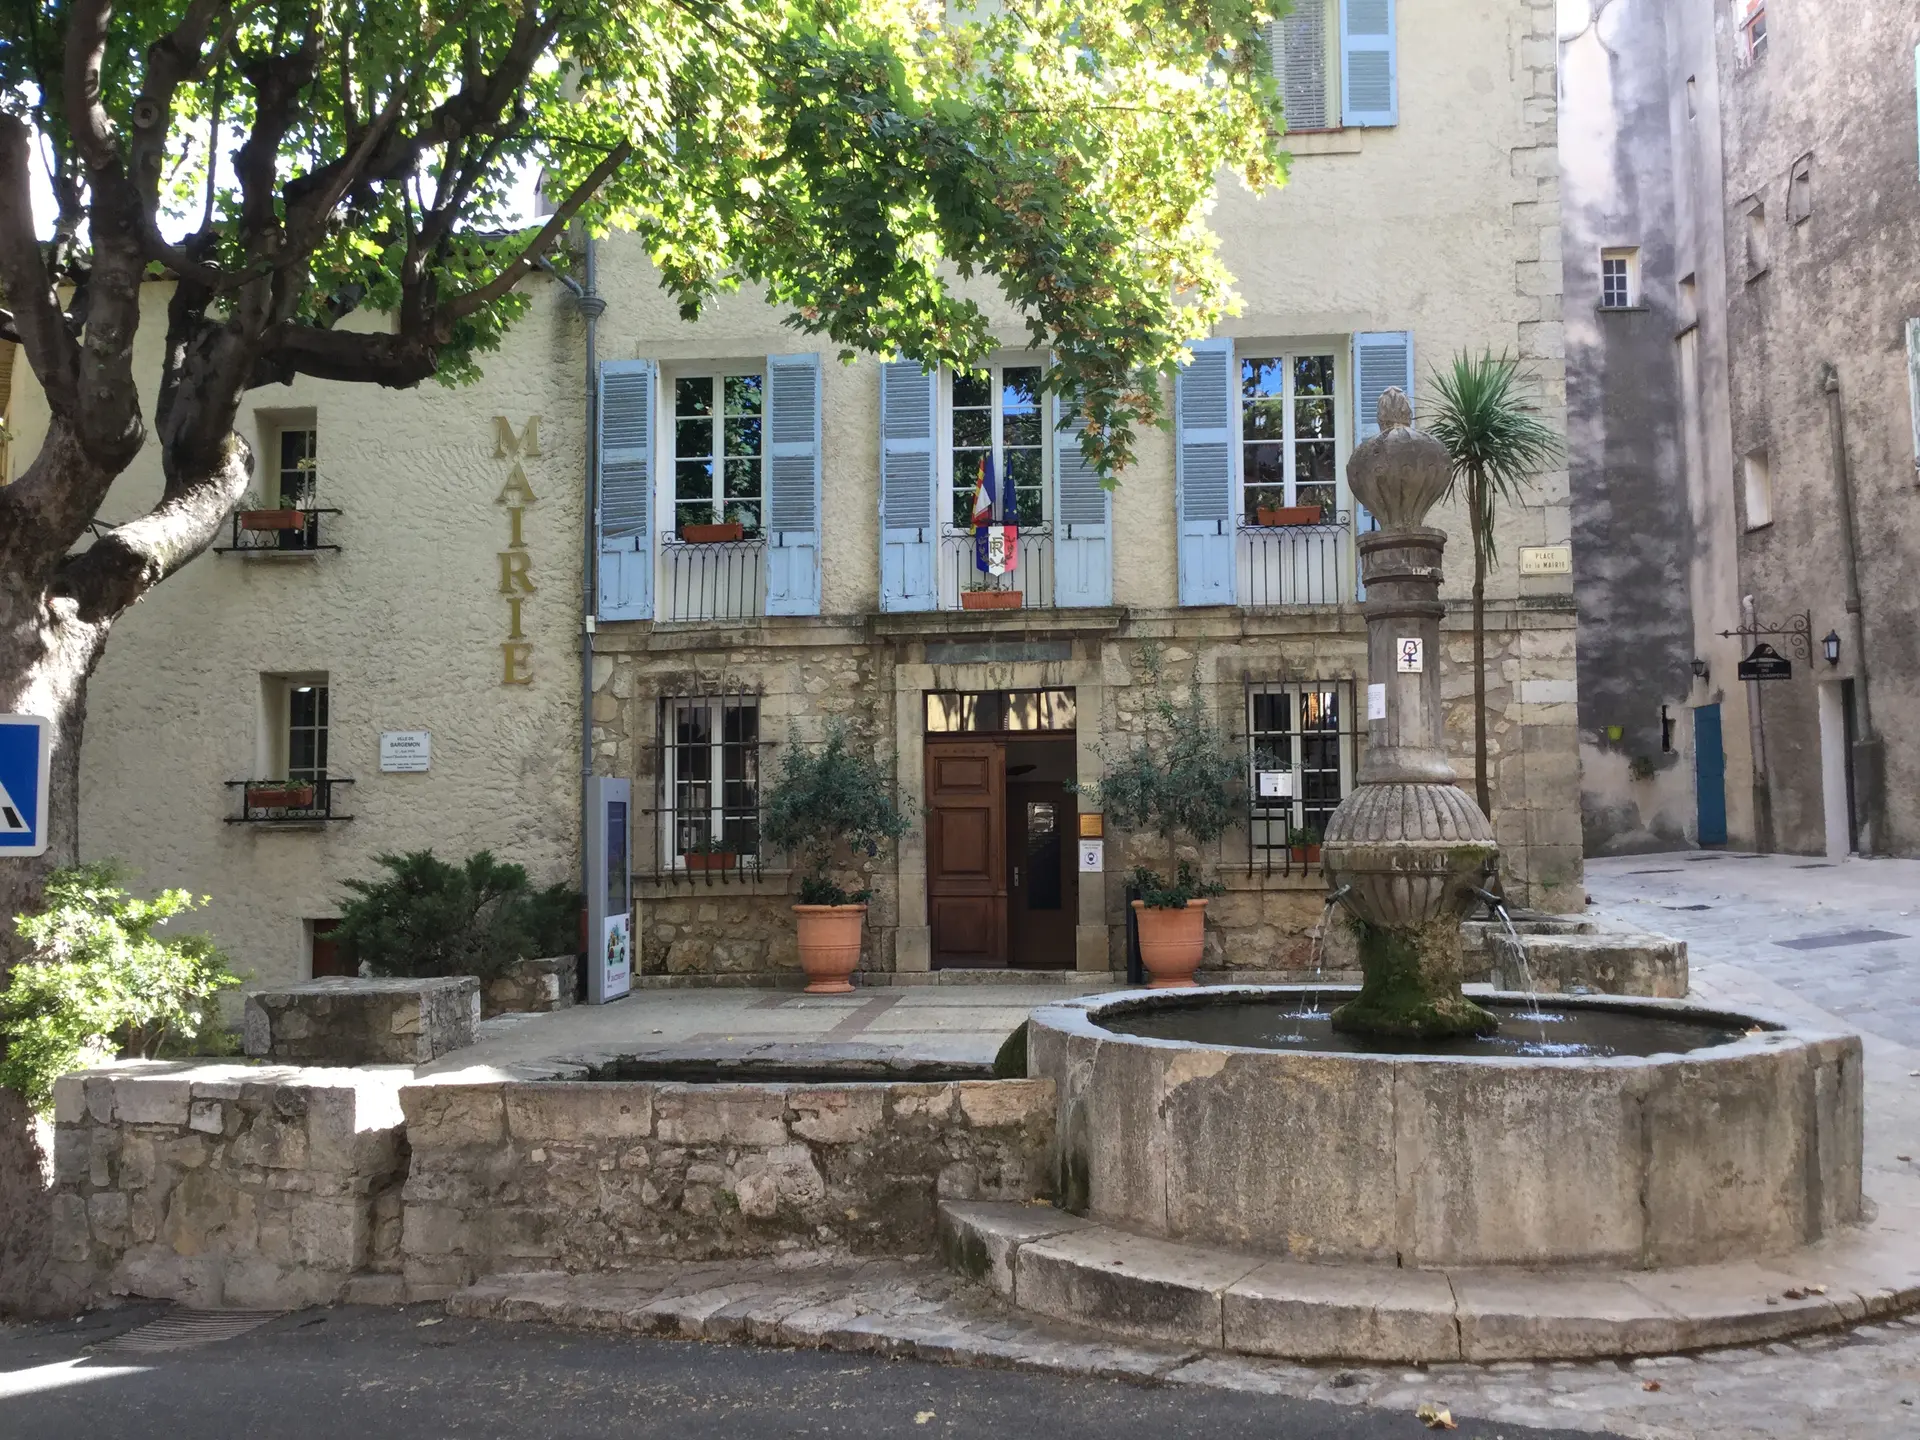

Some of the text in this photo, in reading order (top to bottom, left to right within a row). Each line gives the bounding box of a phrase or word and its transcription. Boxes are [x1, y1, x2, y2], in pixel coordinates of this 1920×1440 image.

[491, 414, 543, 686] MAIRIE
[1534, 561, 1540, 569] la
[1543, 561, 1565, 569] MAIRIE
